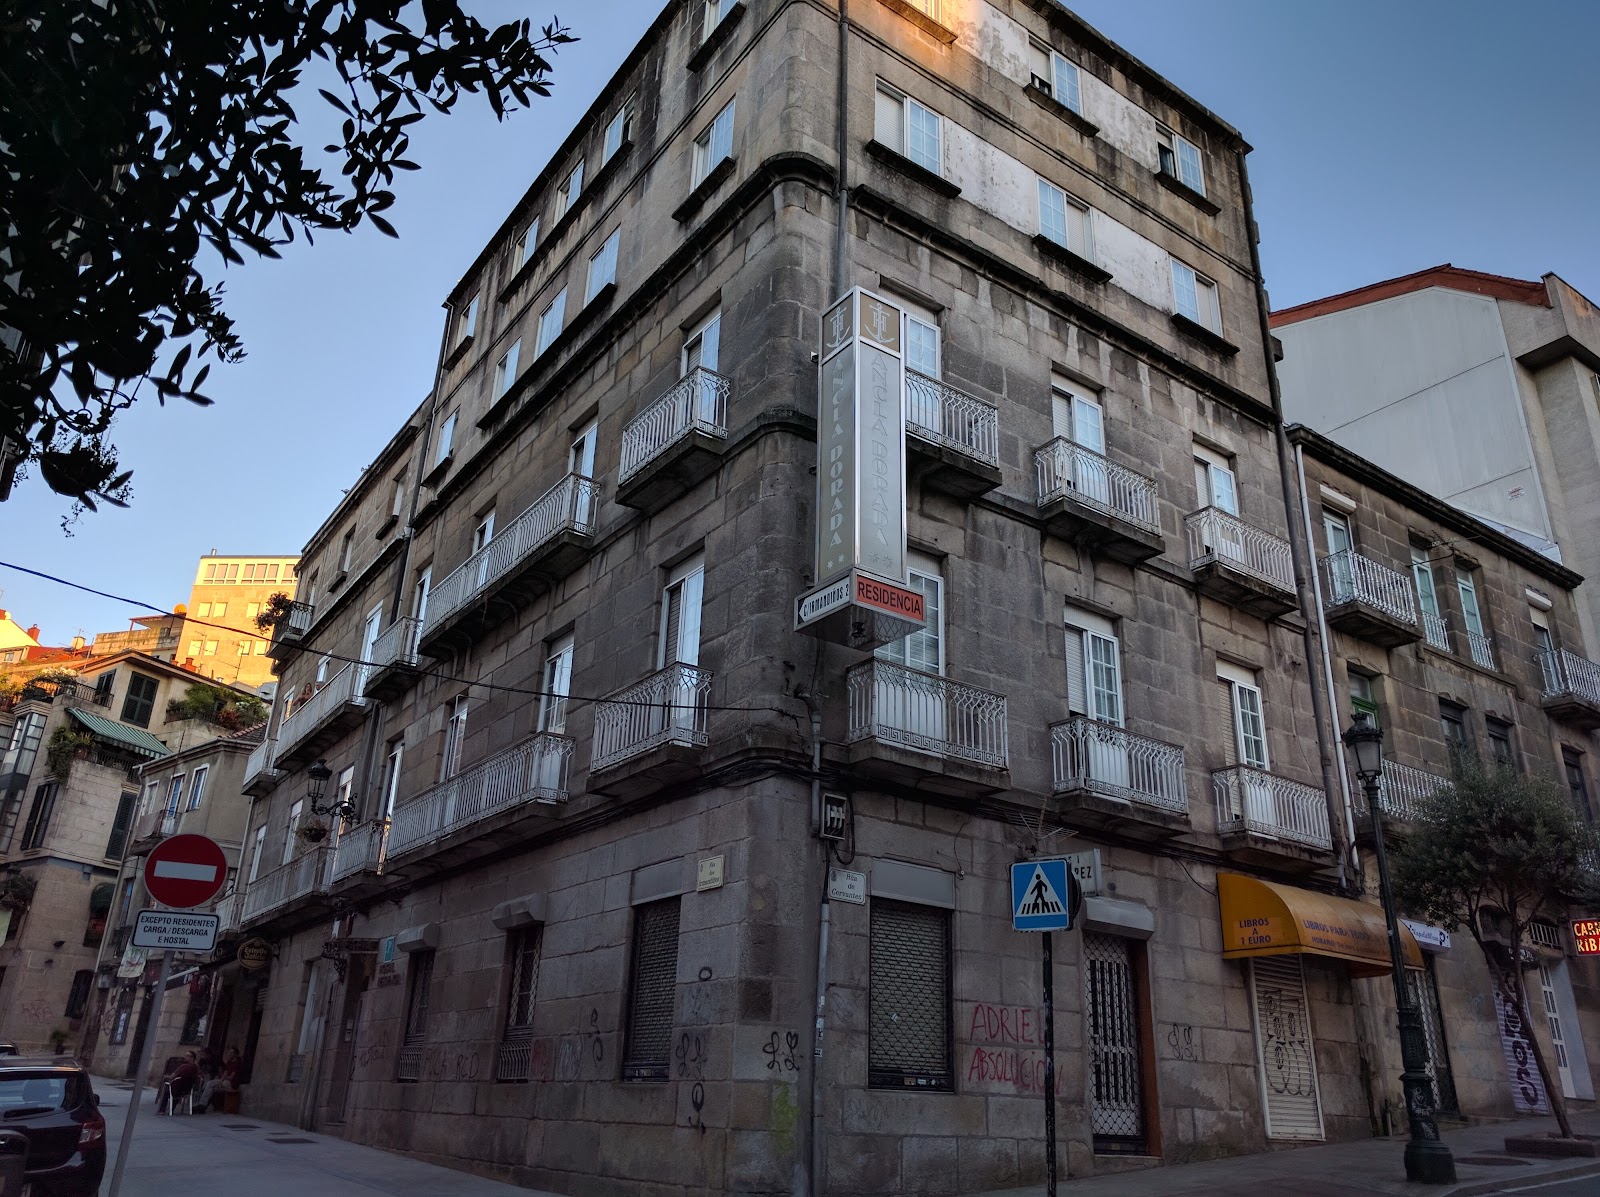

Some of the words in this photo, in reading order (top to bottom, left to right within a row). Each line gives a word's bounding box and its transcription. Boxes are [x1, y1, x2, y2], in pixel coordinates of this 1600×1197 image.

[831, 358, 844, 439] ANCLA
[829, 444, 844, 549] DORADA
[870, 439, 889, 546] DORADA
[858, 580, 922, 616] RESIDENCIA
[831, 888, 862, 900] Cervantes
[140, 915, 172, 925] EXCEPTO
[172, 917, 215, 928] RESIDENTES
[1239, 918, 1269, 929] LIBROS
[1303, 919, 1329, 933] LIBROS
[143, 925, 167, 935] CARGA
[172, 927, 208, 937] DESCARGA
[1252, 928, 1259, 936] A
[164, 936, 190, 945] HOSTAL
[1248, 935, 1271, 945] EURO
[970, 1003, 1046, 1045] ADRIEL
[455, 1052, 481, 1080] RCD
